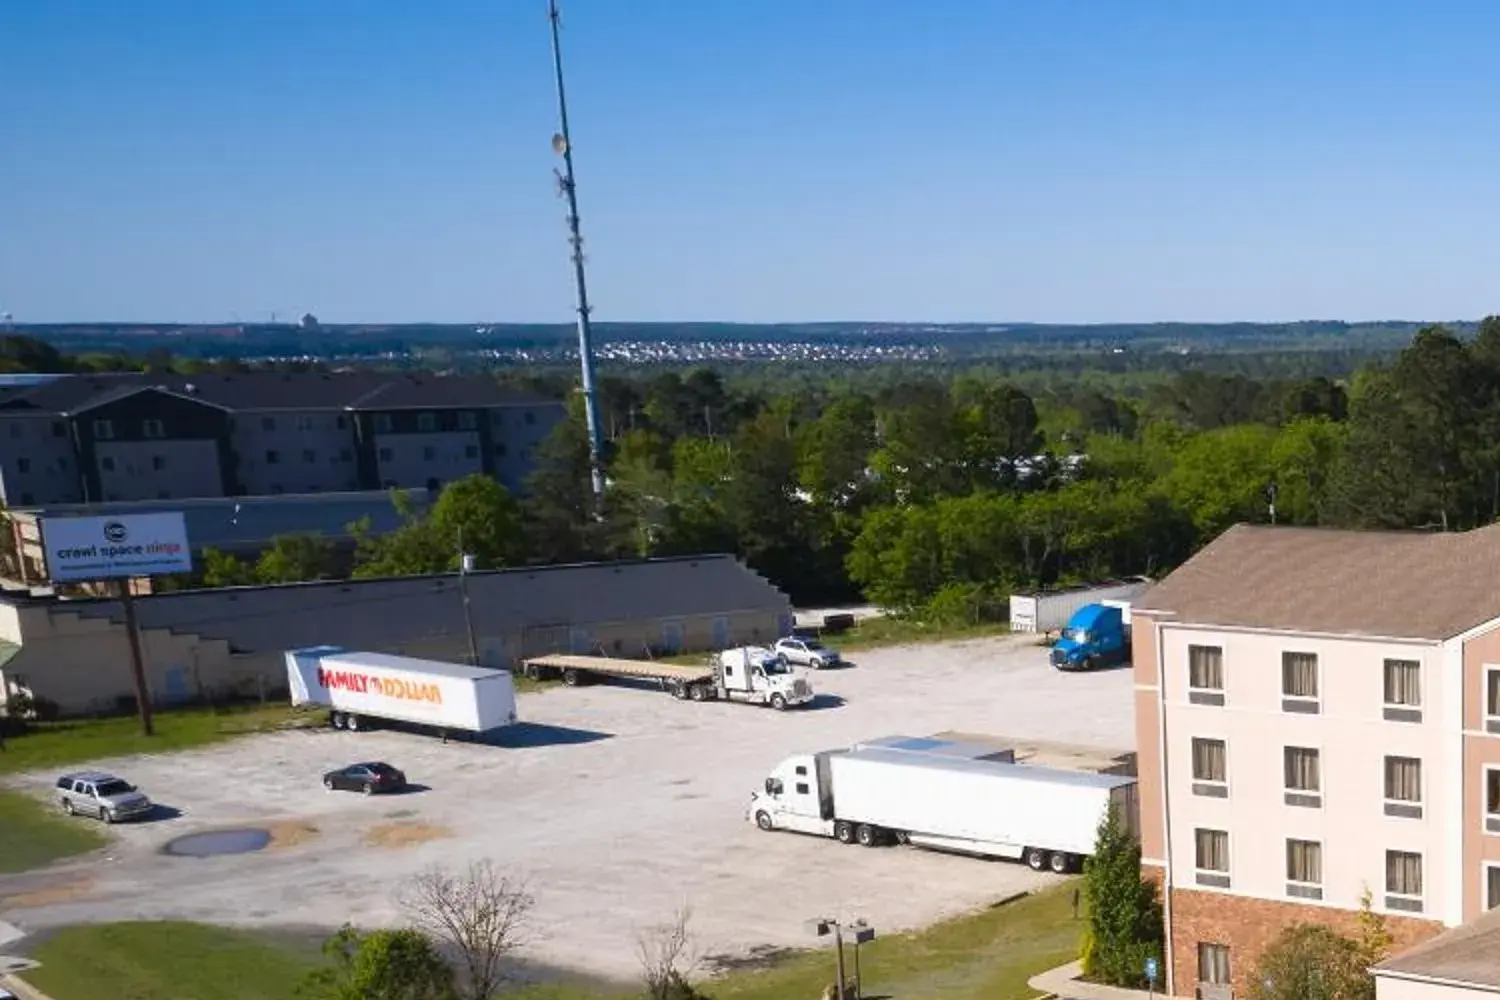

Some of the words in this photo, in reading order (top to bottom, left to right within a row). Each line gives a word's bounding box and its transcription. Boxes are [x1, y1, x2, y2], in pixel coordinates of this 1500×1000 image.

[57, 543, 97, 560] crawl
[318, 666, 369, 694] FAMILY
[383, 677, 443, 705] DOLLAR
